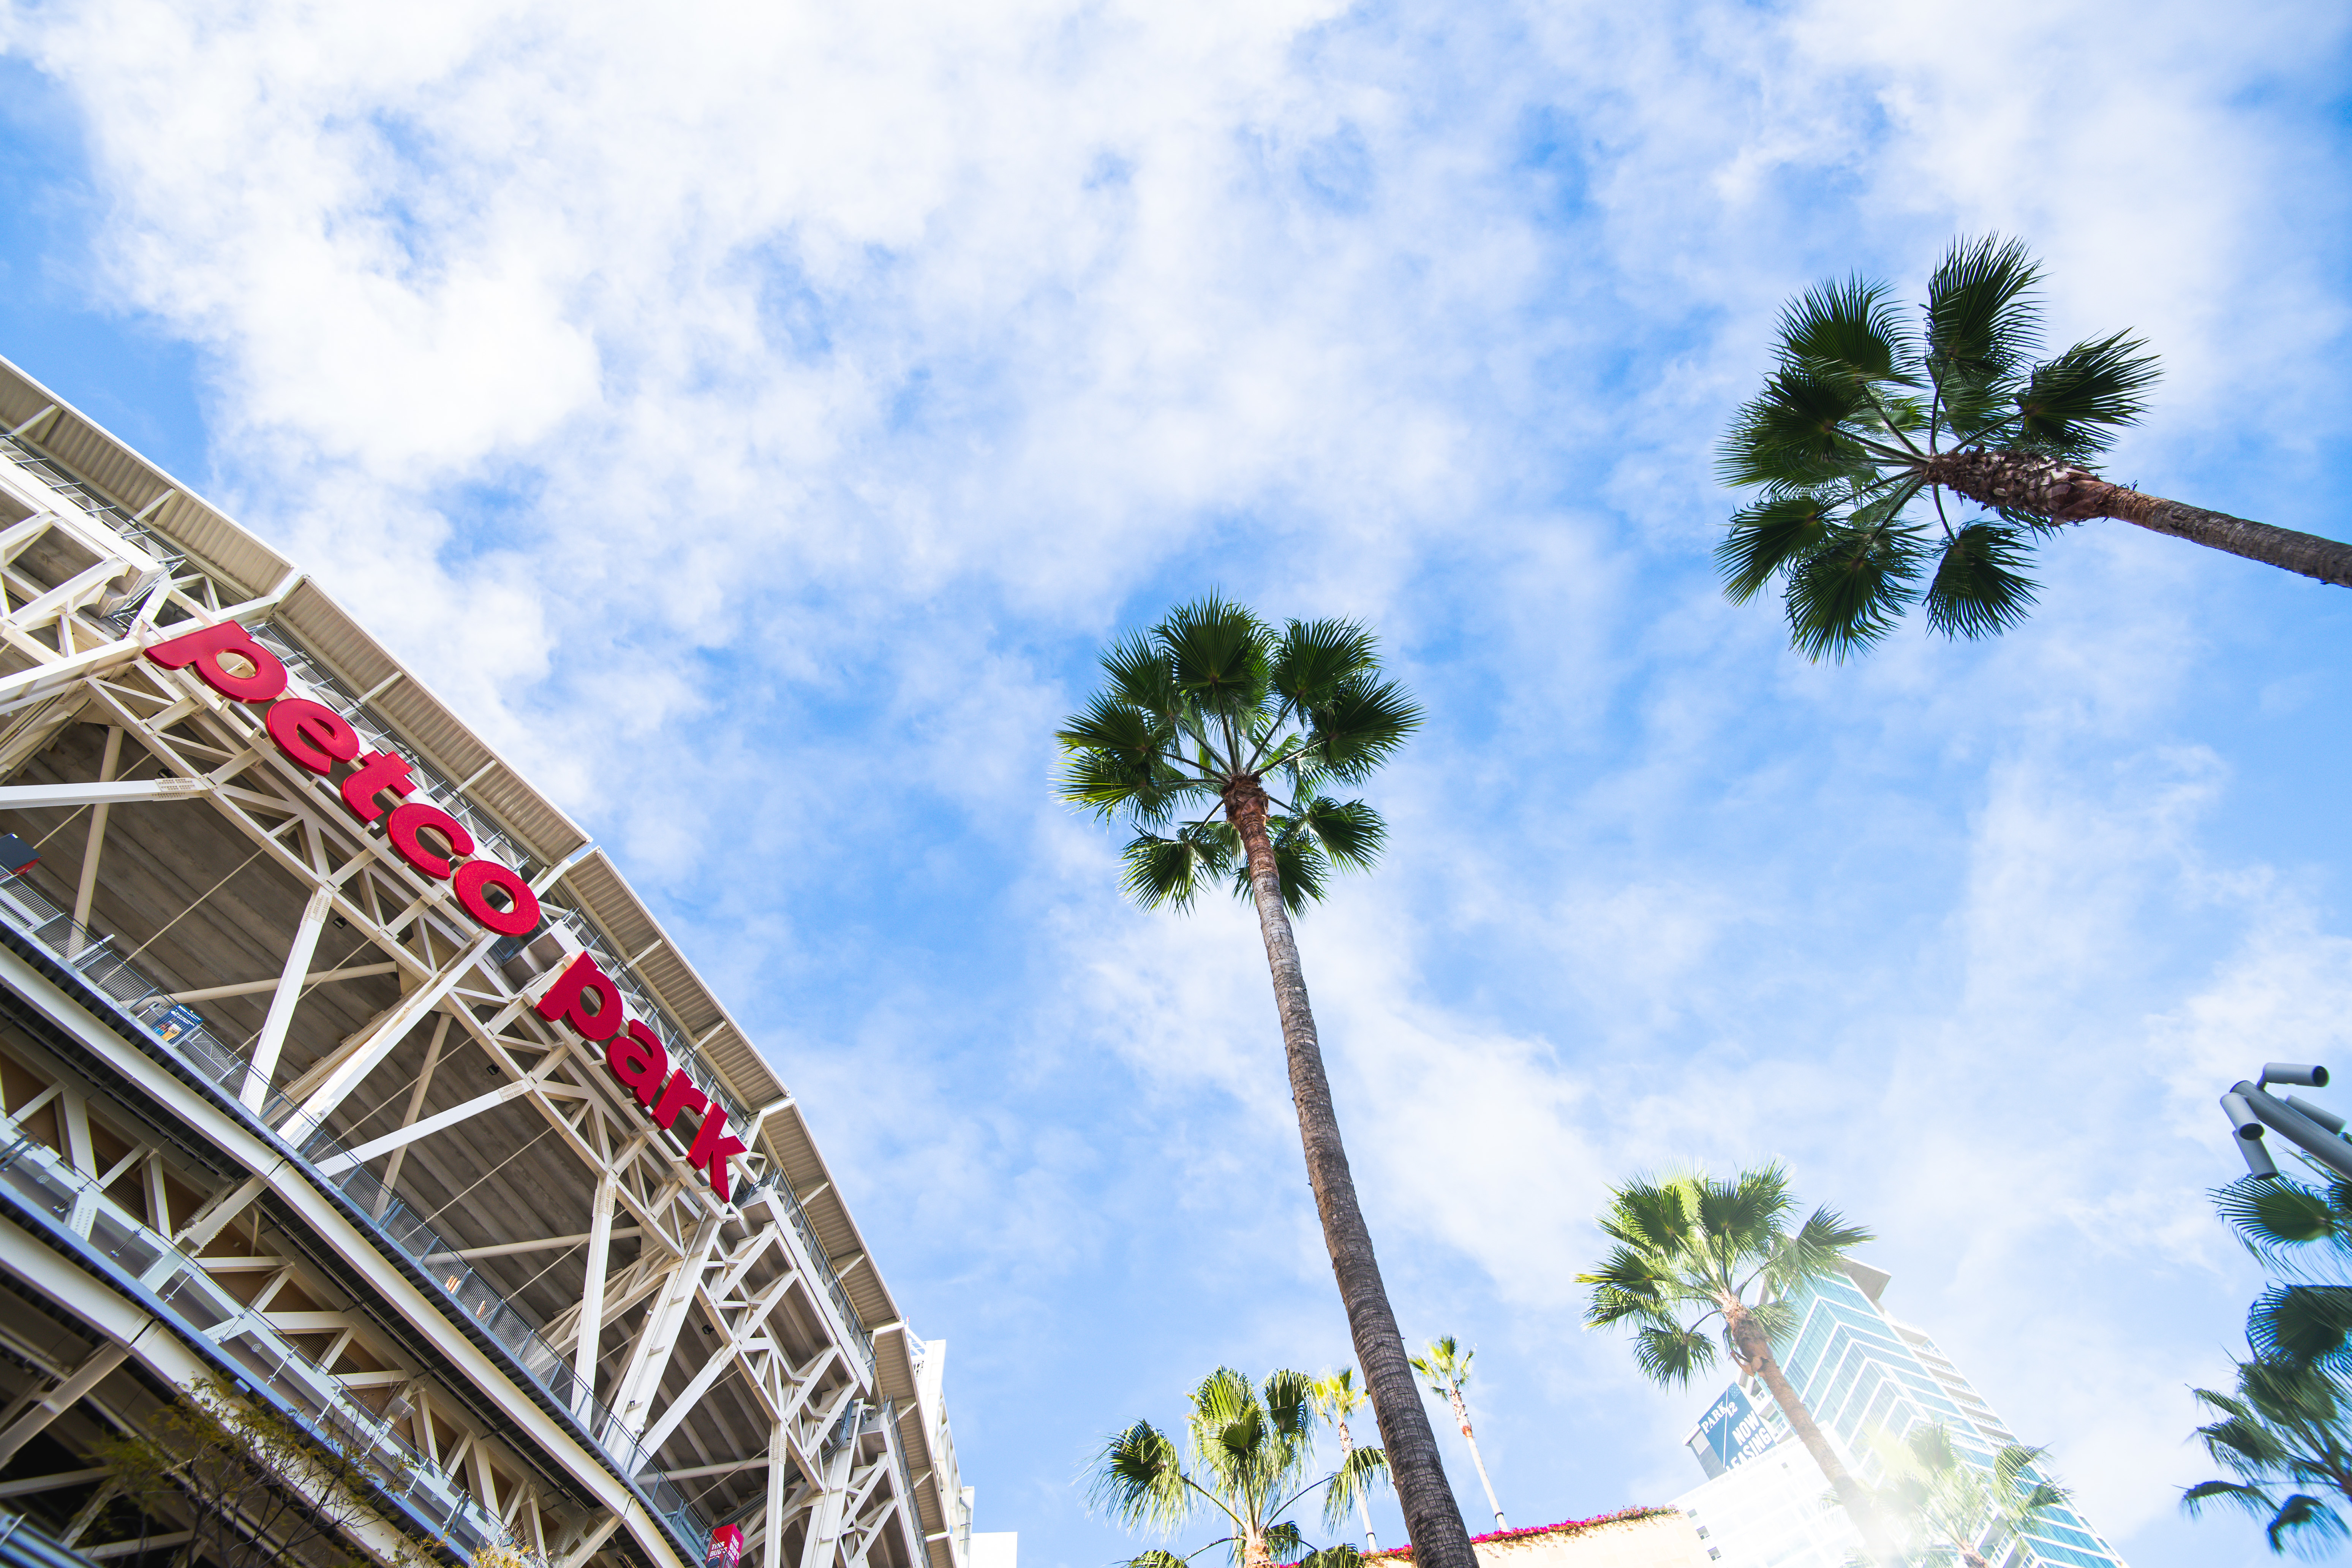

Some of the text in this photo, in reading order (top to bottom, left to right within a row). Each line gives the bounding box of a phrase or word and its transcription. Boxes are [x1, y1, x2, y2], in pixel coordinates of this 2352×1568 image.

[143, 620, 746, 1204] petco park
[1701, 1401, 1738, 1434] PARK 12
[1732, 1410, 1760, 1446] NOW
[729, 1542, 740, 1560] BUD'S
